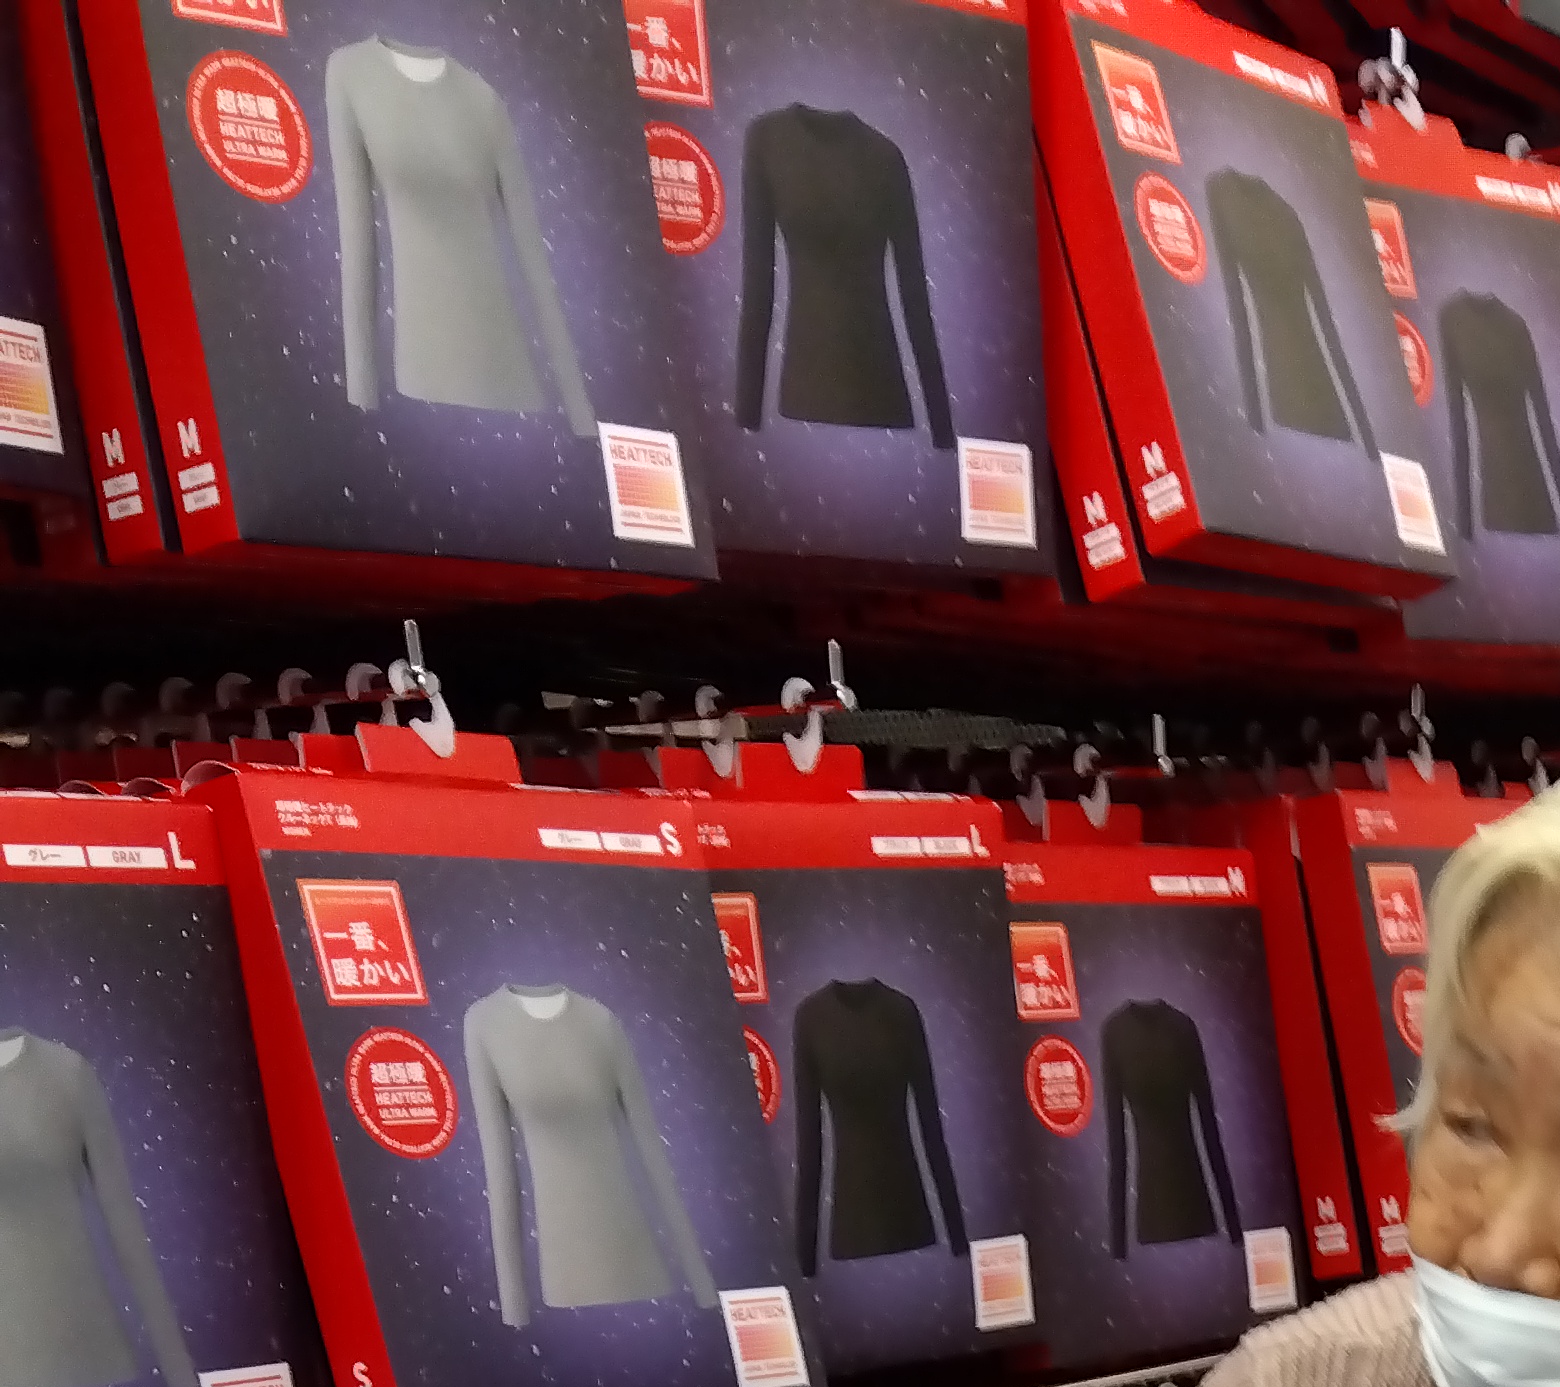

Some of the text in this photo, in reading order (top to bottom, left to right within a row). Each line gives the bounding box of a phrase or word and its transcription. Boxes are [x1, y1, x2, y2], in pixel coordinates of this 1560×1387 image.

[0, 338, 42, 363] ATTECH
[102, 428, 126, 468] M
[177, 418, 202, 459] M
[609, 443, 673, 467] HEATTECH
[28, 831, 197, 870] グレー GRAY L
[660, 822, 683, 857] S
[969, 824, 990, 858] L
[323, 921, 390, 951] 一番、
[331, 957, 412, 988] 暖かい
[374, 1090, 433, 1106] HEATTECH
